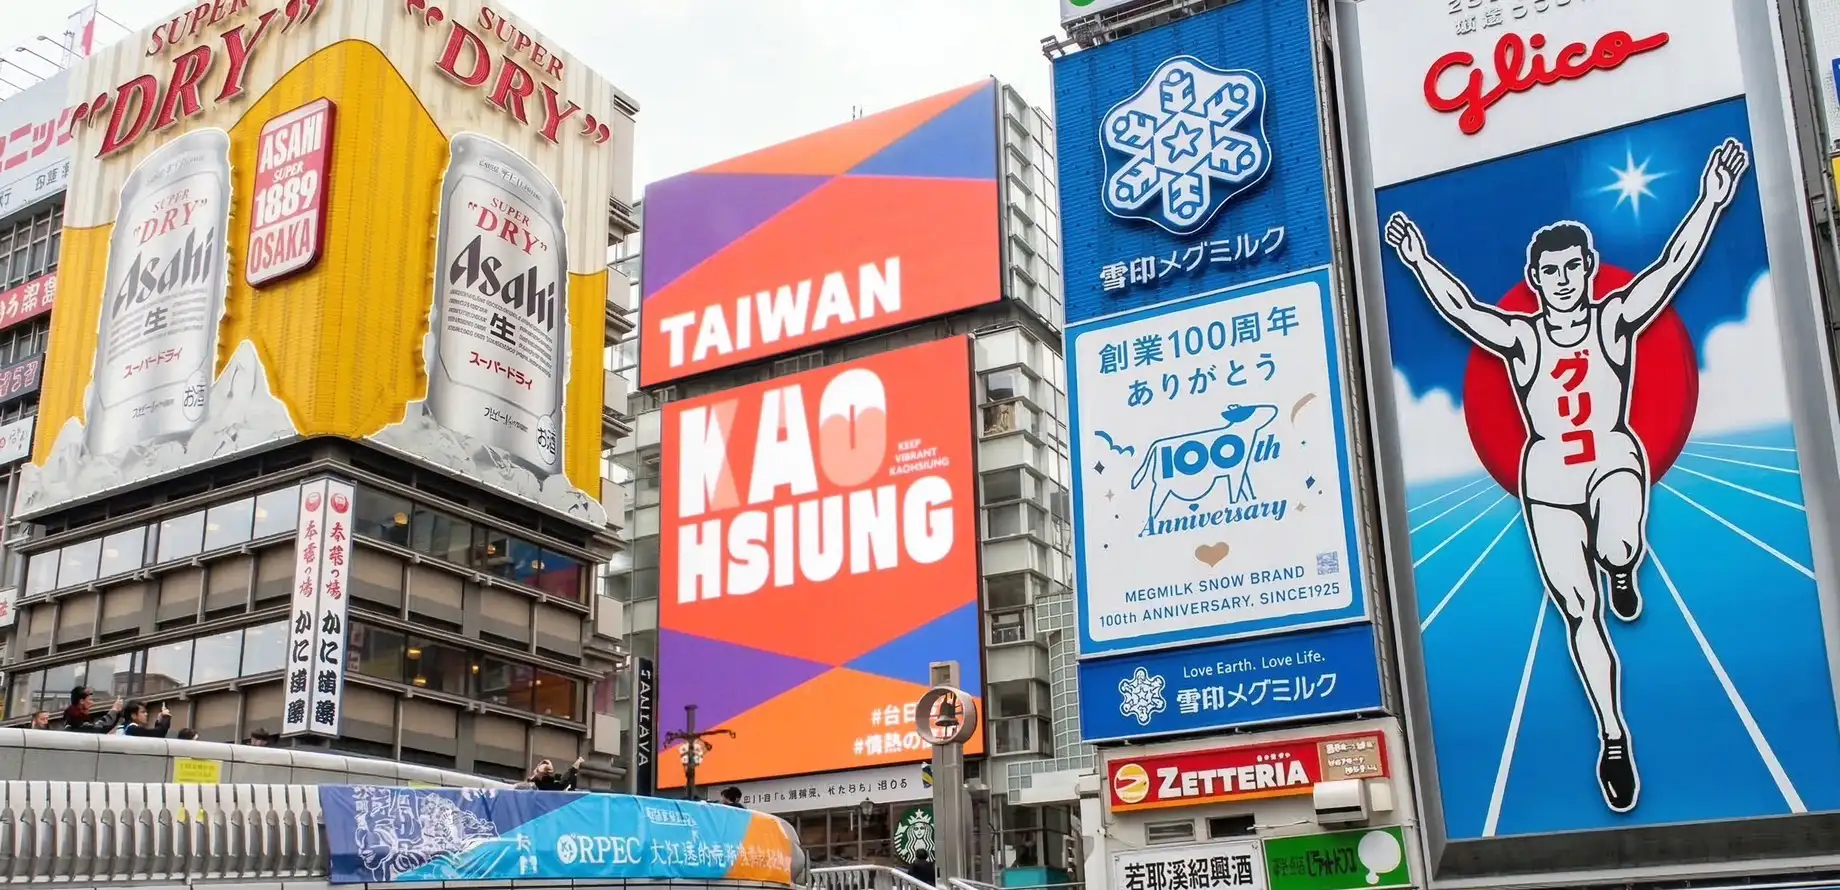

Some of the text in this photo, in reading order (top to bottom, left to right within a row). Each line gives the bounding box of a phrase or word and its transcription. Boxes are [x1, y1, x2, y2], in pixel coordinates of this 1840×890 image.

[478, 6, 565, 82] SUPER
[1423, 32, 1670, 134] Glico
[259, 110, 325, 174] ASAHI
[272, 160, 304, 184] SUPER
[152, 188, 190, 214] SUPER
[255, 169, 318, 229] 1889
[491, 197, 531, 227] SUPER
[249, 217, 311, 275] OSAKA
[1099, 225, 1285, 292] 雪印メグミルク
[111, 226, 214, 321] Asahi
[449, 233, 555, 333] Asahi
[143, 306, 169, 336] 生
[489, 311, 517, 346] 生
[660, 256, 901, 368] TAIWAN
[1098, 305, 1300, 375] 創業100周年
[469, 350, 534, 391] スーパードライ
[1127, 352, 1277, 408] ありがとう
[1550, 349, 1597, 466] グリコ
[679, 368, 887, 519] KAO
[888, 456, 950, 477] KAOHSIUNG
[895, 447, 938, 463] VIBRANT
[677, 475, 954, 604] HSIUNG
[1137, 498, 1288, 538] Anniversary
[1099, 613, 1138, 628] 100th
[1260, 582, 1341, 605] SINCE1925
[1125, 565, 1306, 603] MEGMILK SNOW BRAND
[1183, 649, 1326, 679] Love Earth. Love Life.
[1176, 672, 1338, 715] 雪印メグミルク
[1156, 760, 1309, 799] ZETTERIA
